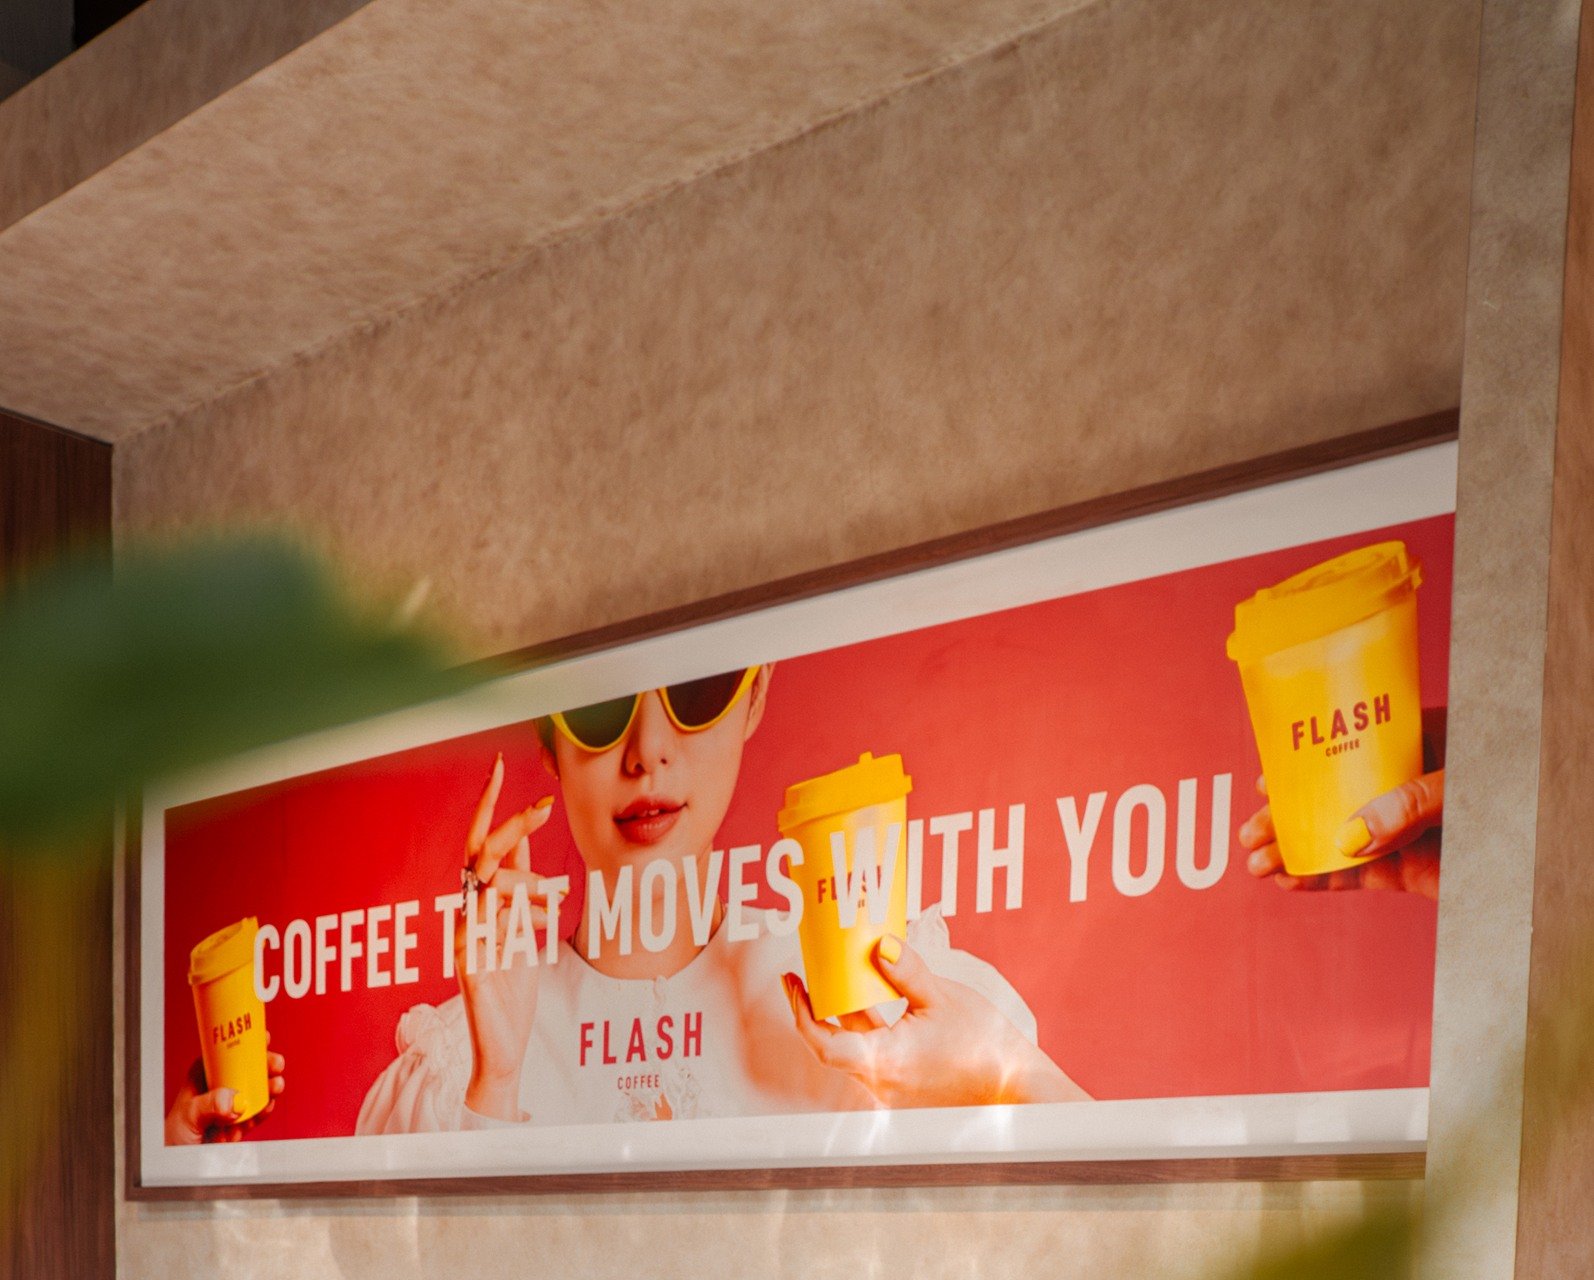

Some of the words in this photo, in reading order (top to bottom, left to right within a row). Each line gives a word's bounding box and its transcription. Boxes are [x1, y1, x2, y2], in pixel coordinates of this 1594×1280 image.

[1291, 693, 1391, 751] FLASH
[1325, 739, 1360, 757] COFFEE
[253, 899, 420, 1003] COFFEE
[434, 874, 570, 979] THAT
[587, 838, 805, 960] MOVES
[829, 803, 1026, 929] WITH
[1056, 772, 1233, 903] YOU
[213, 1012, 252, 1045] FLASH
[579, 1011, 703, 1067] FLASH
[617, 1073, 660, 1090] COFFEE
